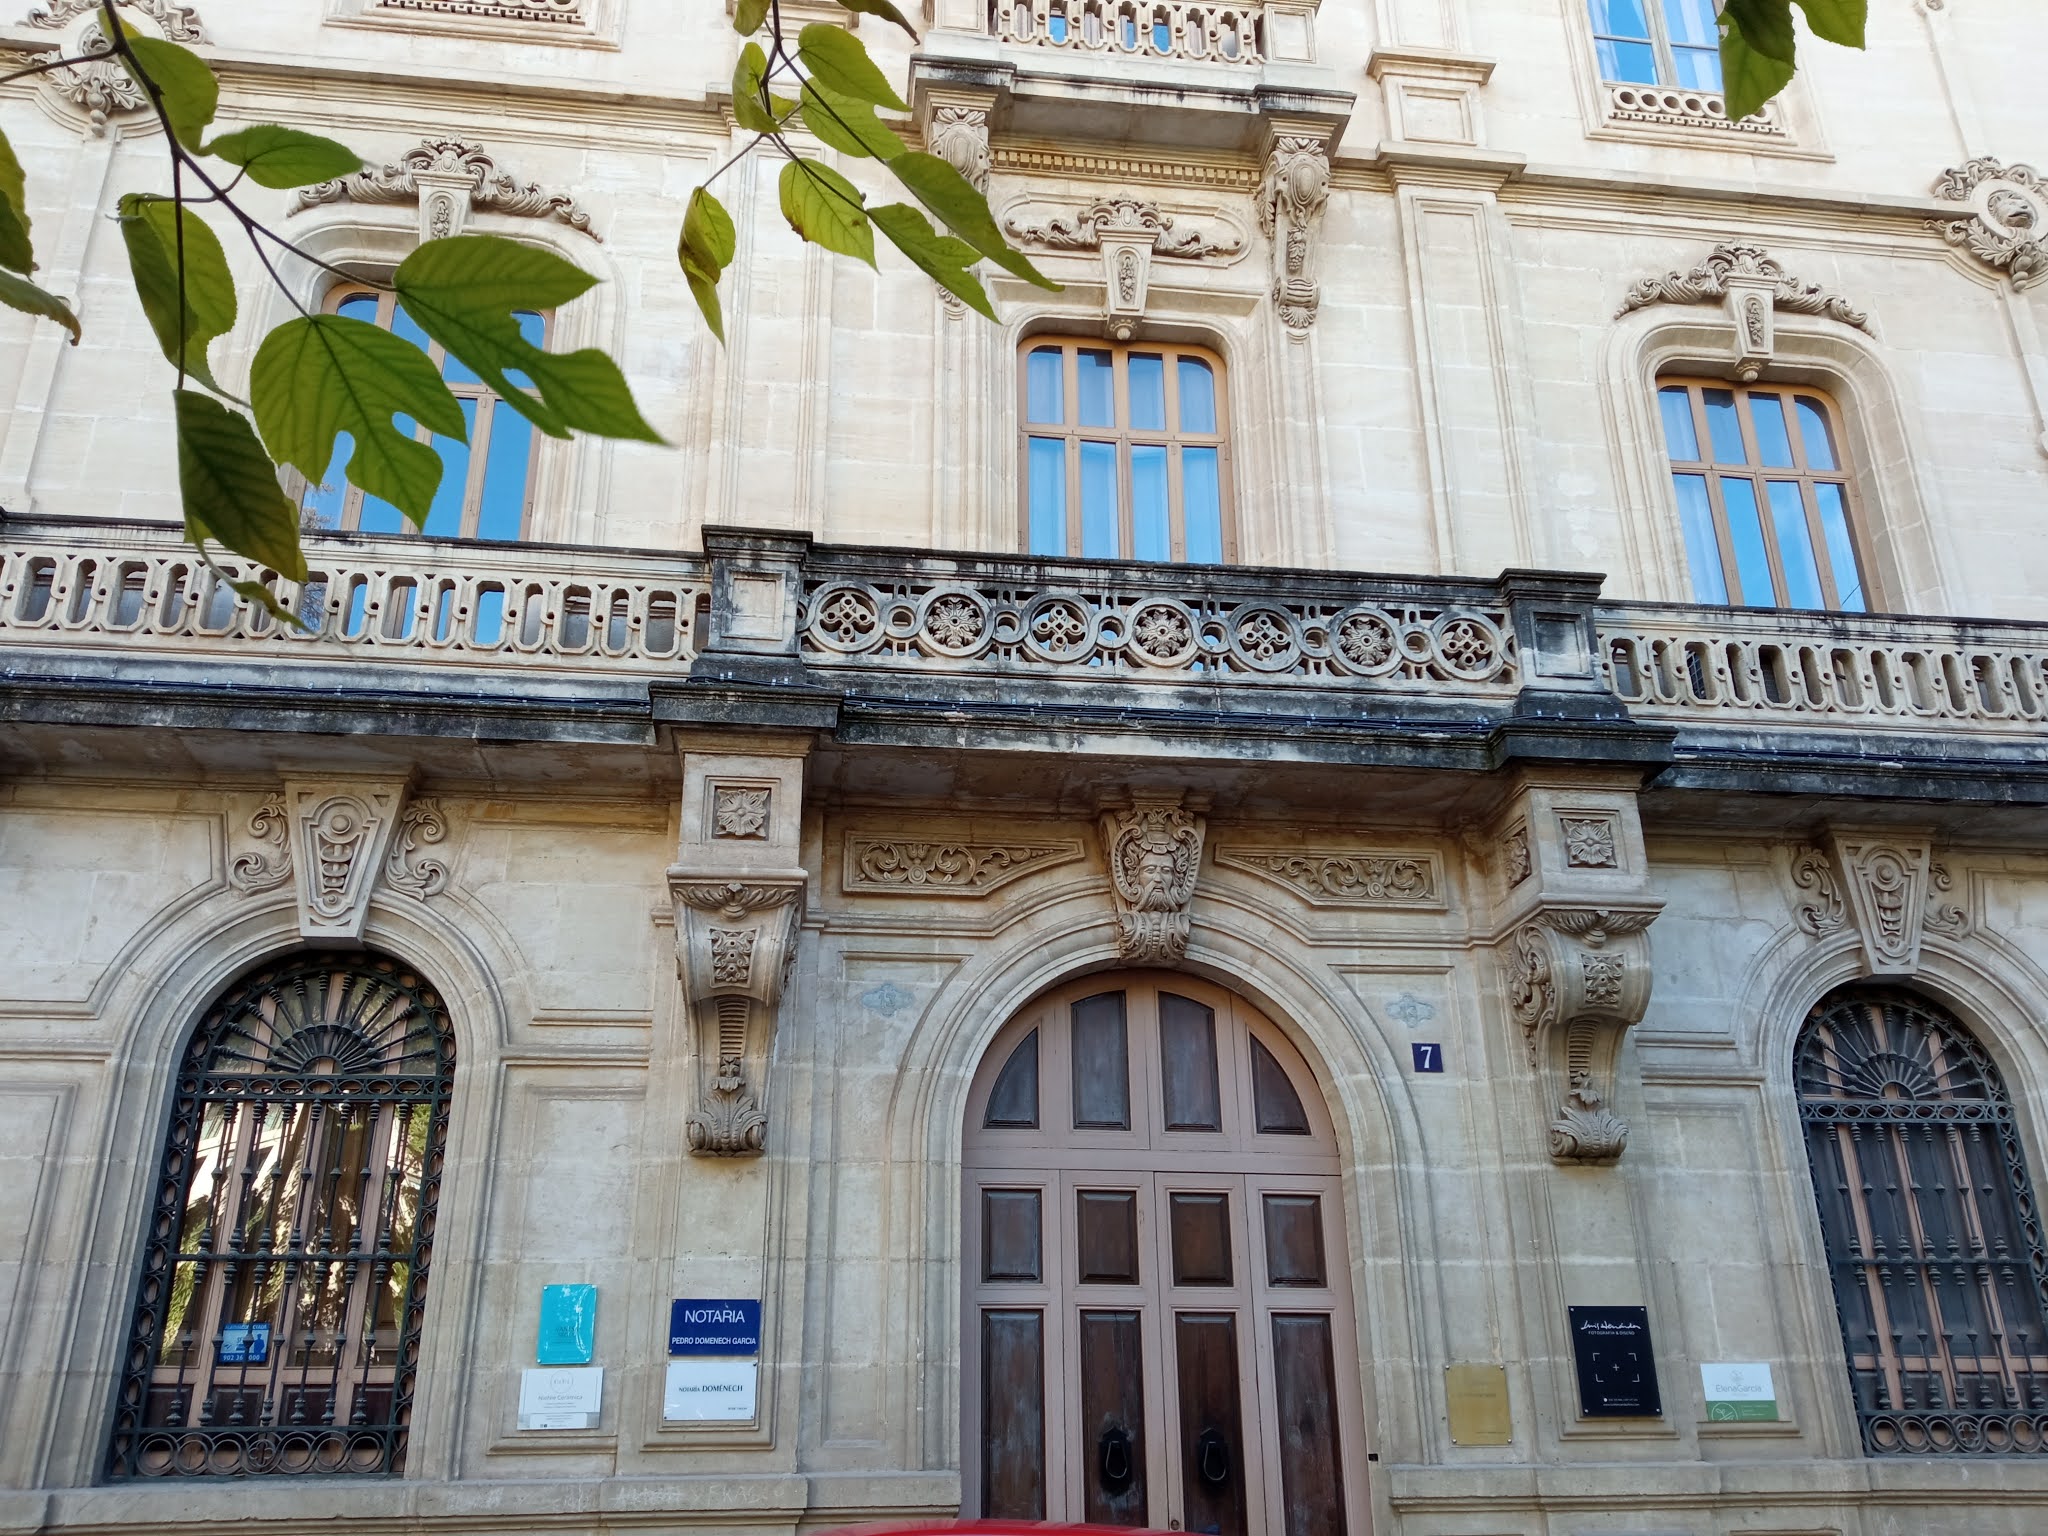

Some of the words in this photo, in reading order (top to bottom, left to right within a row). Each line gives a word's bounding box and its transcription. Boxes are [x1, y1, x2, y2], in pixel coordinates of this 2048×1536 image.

[1420, 1046, 1432, 1068] 7
[684, 1309, 746, 1324] NOTARIA
[671, 1337, 694, 1345] PEDRO
[694, 1337, 731, 1345] DOMENECH
